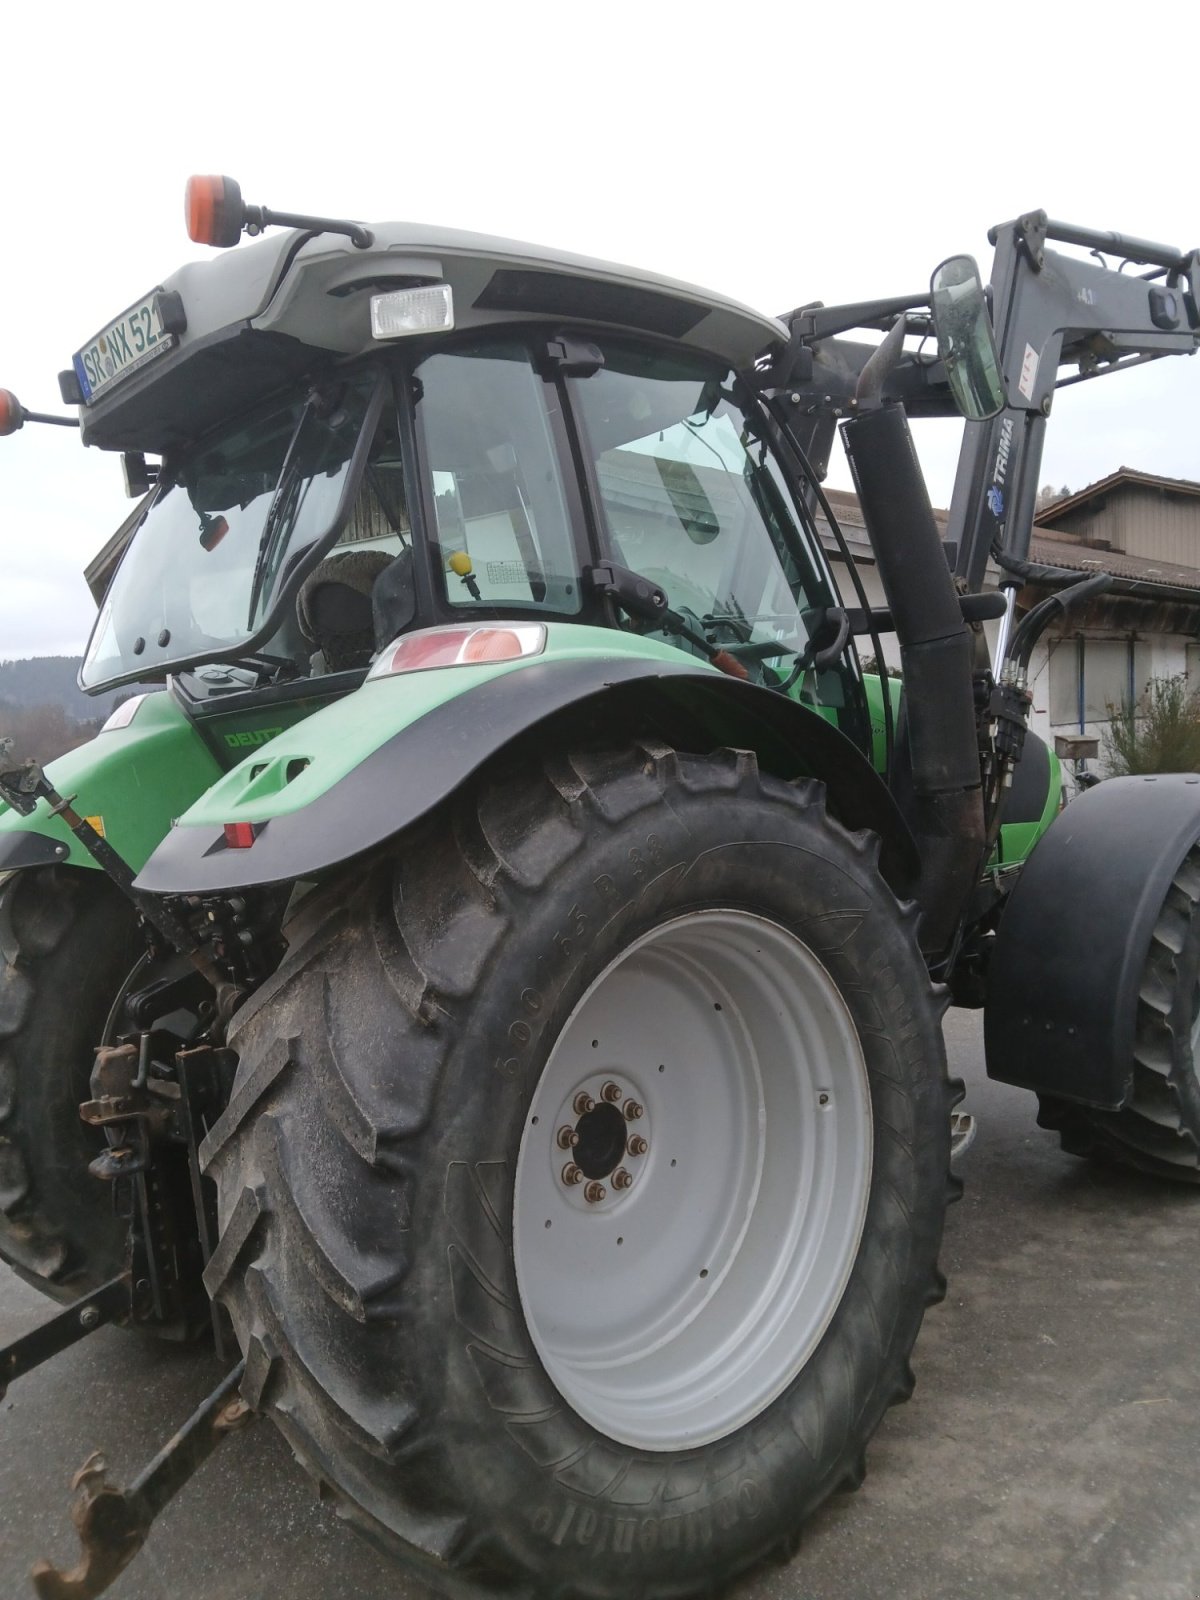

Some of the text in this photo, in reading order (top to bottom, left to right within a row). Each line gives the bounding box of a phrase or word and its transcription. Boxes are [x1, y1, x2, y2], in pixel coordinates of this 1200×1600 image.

[83, 345, 107, 388] SR
[106, 322, 134, 370] NX
[993, 418, 1014, 485] TRIMA
